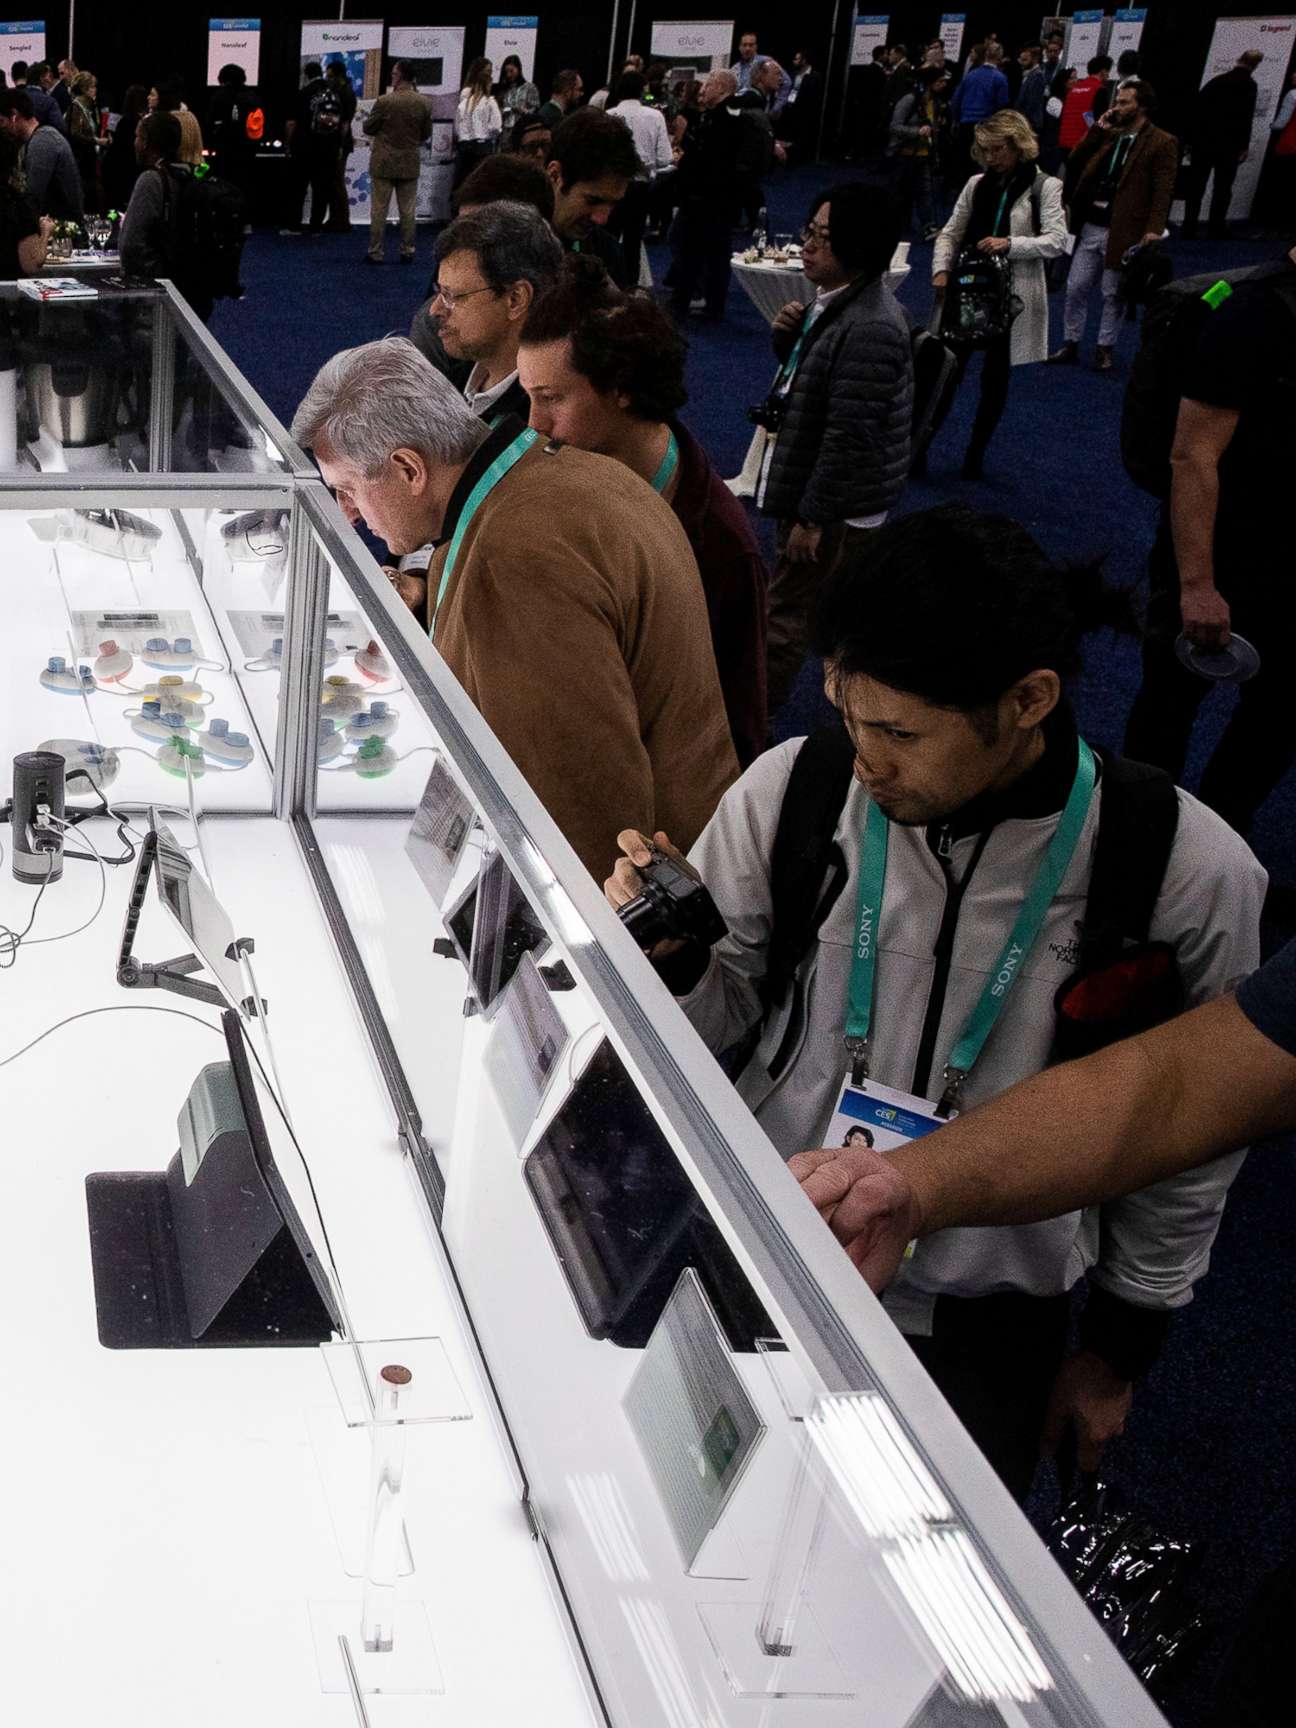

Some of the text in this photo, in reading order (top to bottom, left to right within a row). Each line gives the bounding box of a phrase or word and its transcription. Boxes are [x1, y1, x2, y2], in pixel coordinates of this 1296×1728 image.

[857, 904, 874, 960] SONY
[991, 942, 1023, 997] SONY
[875, 1108, 891, 1120] CES
